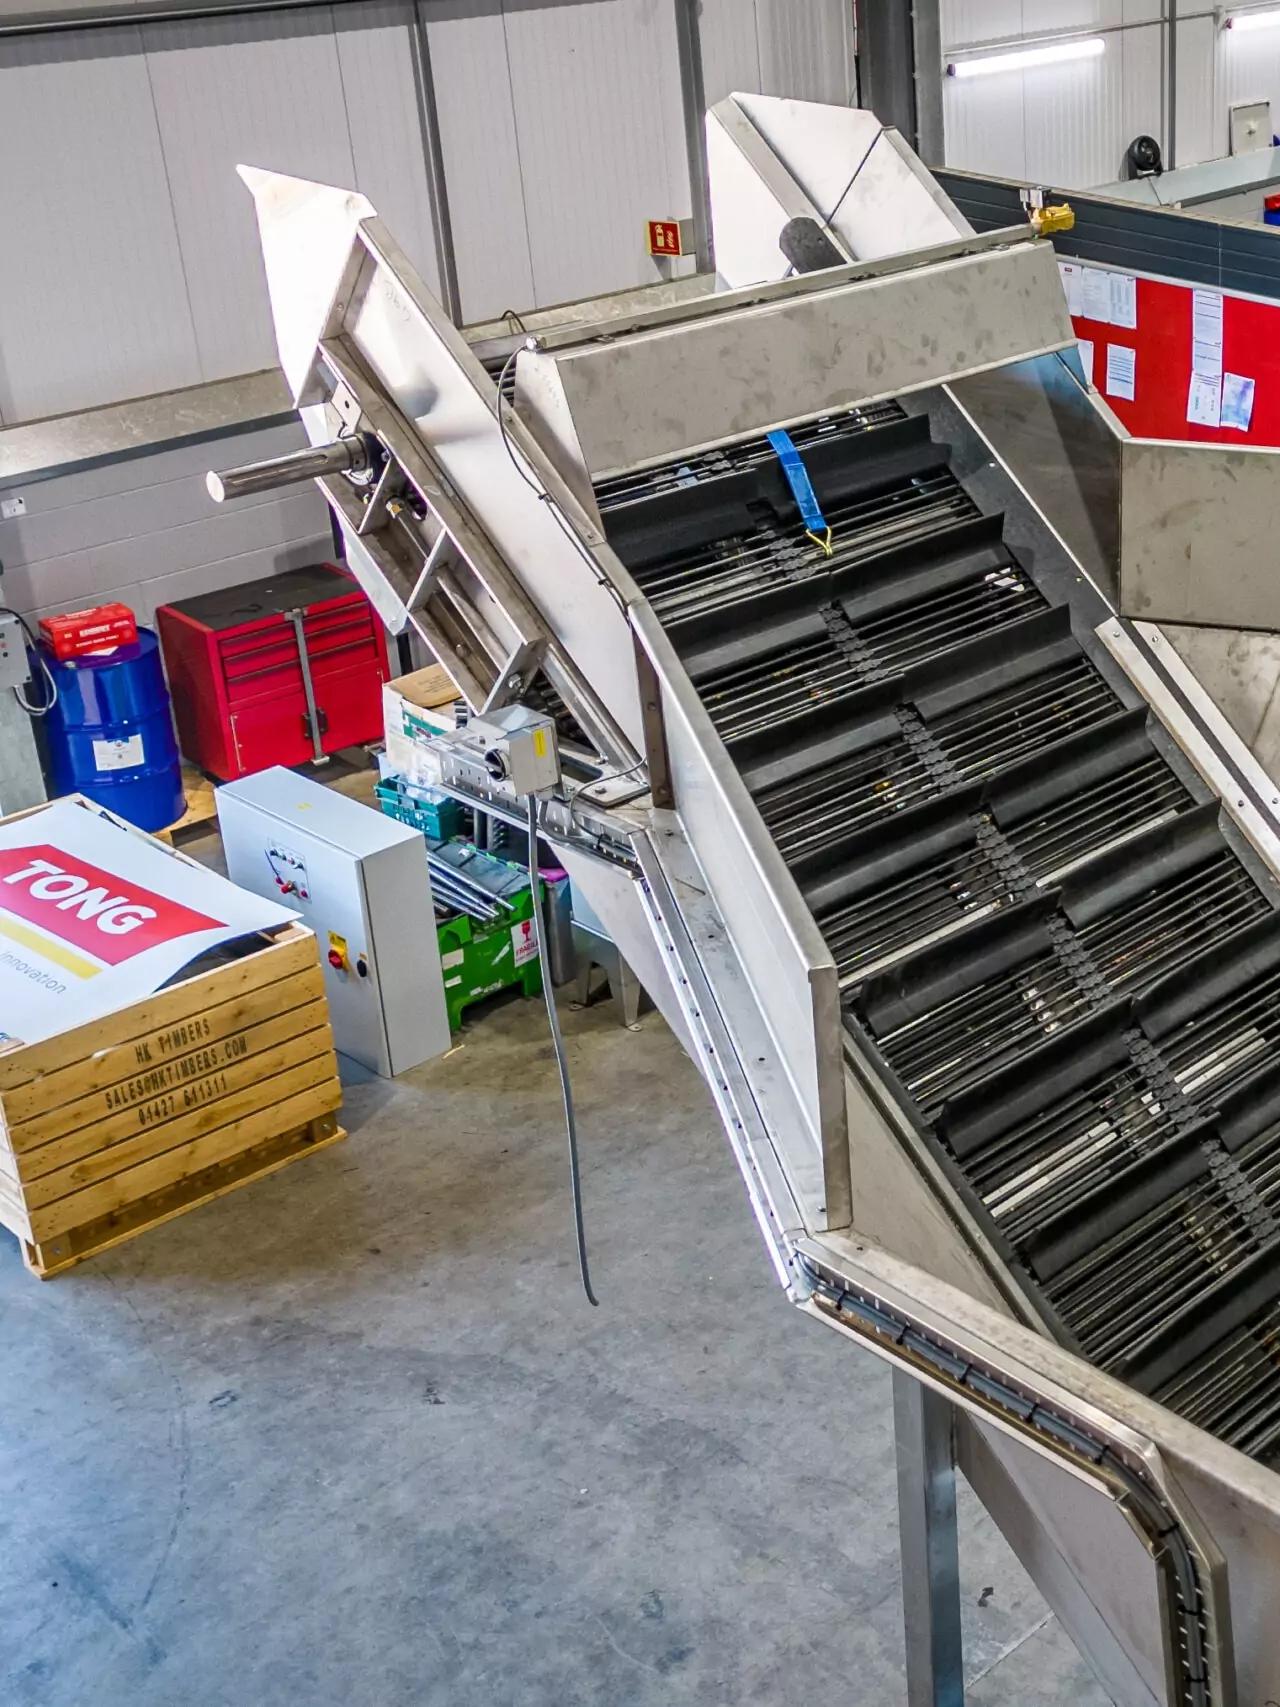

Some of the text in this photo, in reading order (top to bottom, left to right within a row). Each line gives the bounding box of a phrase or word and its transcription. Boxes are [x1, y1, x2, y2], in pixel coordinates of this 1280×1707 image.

[3, 859, 157, 935] TONG
[135, 1018, 210, 1064] HK TIMBERS
